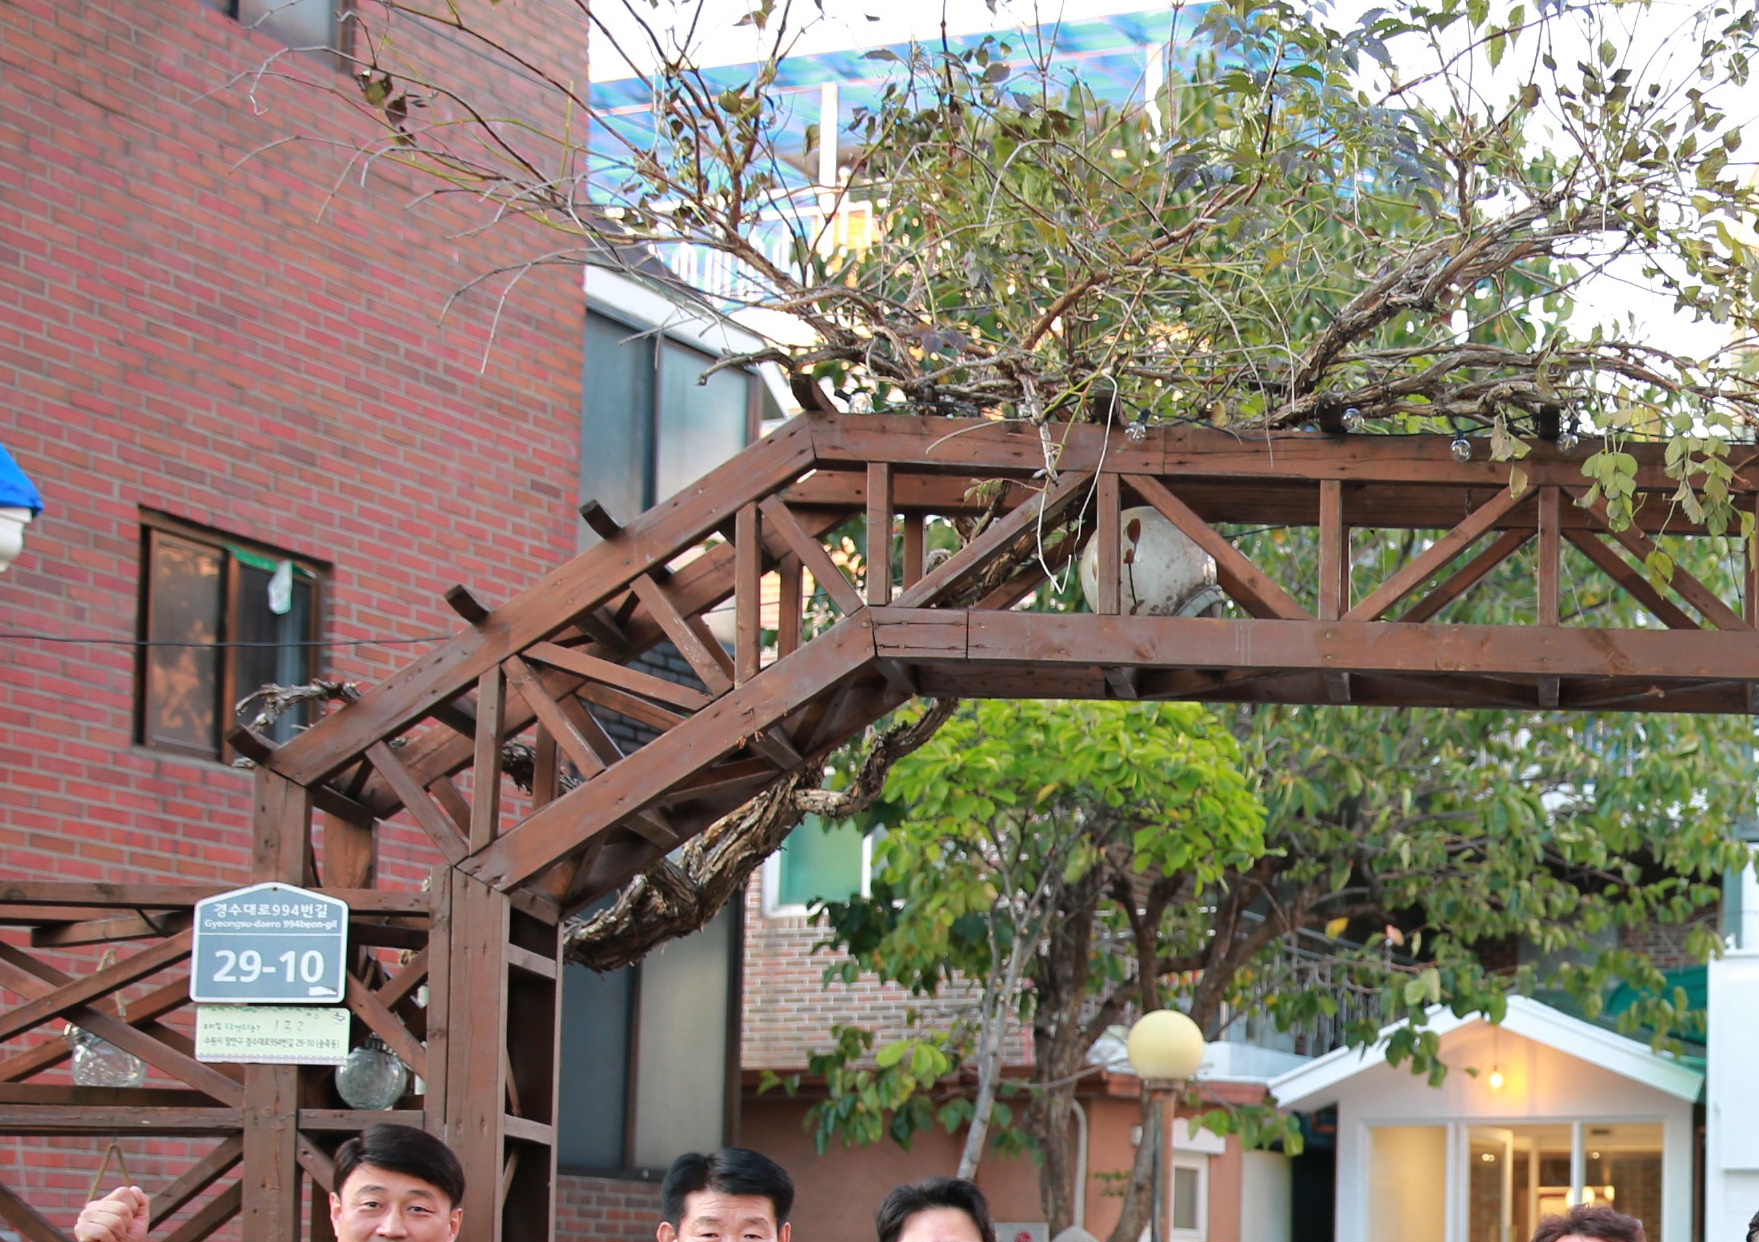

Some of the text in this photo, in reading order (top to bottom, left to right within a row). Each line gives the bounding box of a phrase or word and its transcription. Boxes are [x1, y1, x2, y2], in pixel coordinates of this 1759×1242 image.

[213, 903, 328, 918] 경수대로994번길
[204, 919, 337, 930] Gyeongsu-daero 994beon-gil
[212, 950, 325, 982] 29-10
